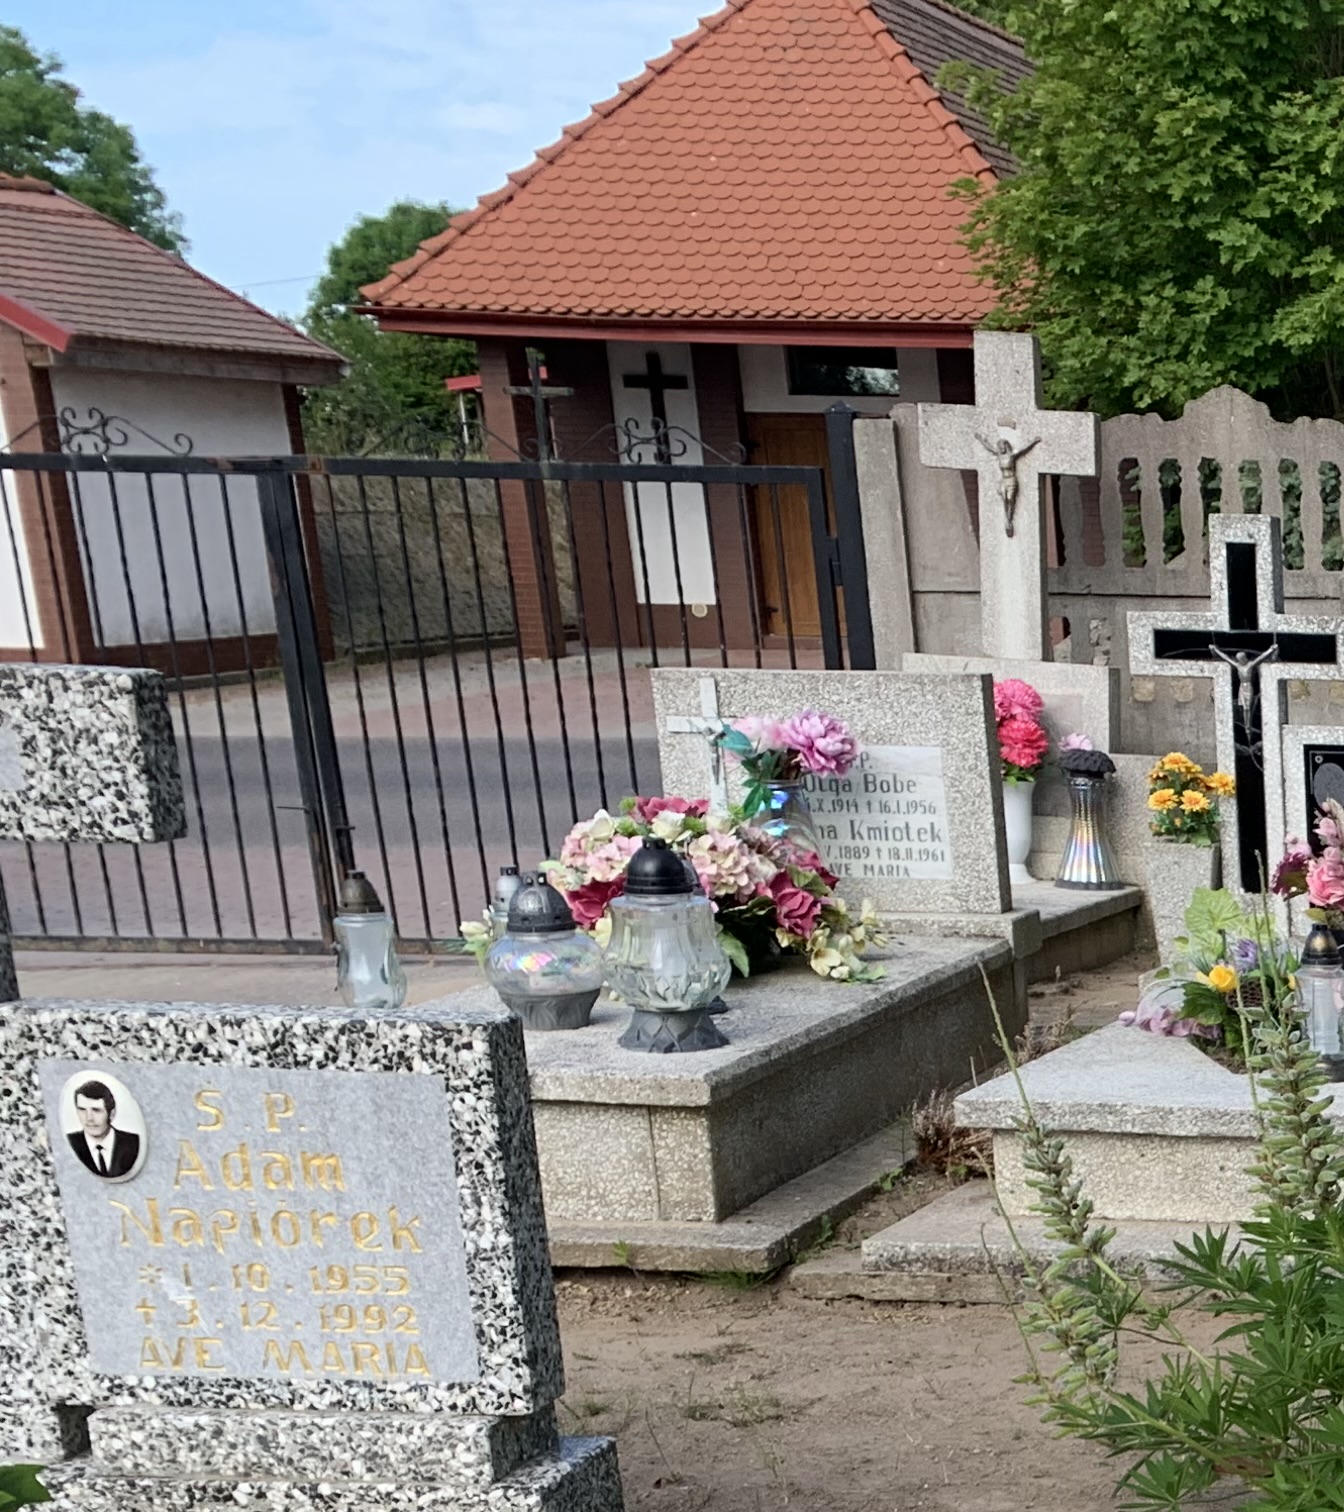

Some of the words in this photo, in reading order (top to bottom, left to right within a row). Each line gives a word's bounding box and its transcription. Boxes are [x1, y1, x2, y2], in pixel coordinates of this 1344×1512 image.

[863, 773, 918, 794] Bobe
[849, 819, 943, 843] Kmiotek
[829, 863, 852, 876] AVE
[863, 864, 911, 878] MARIA
[172, 1139, 348, 1192] Adam
[109, 1197, 424, 1256] Napiórek
[139, 1335, 227, 1373] AVE
[261, 1338, 431, 1378] MARIA
